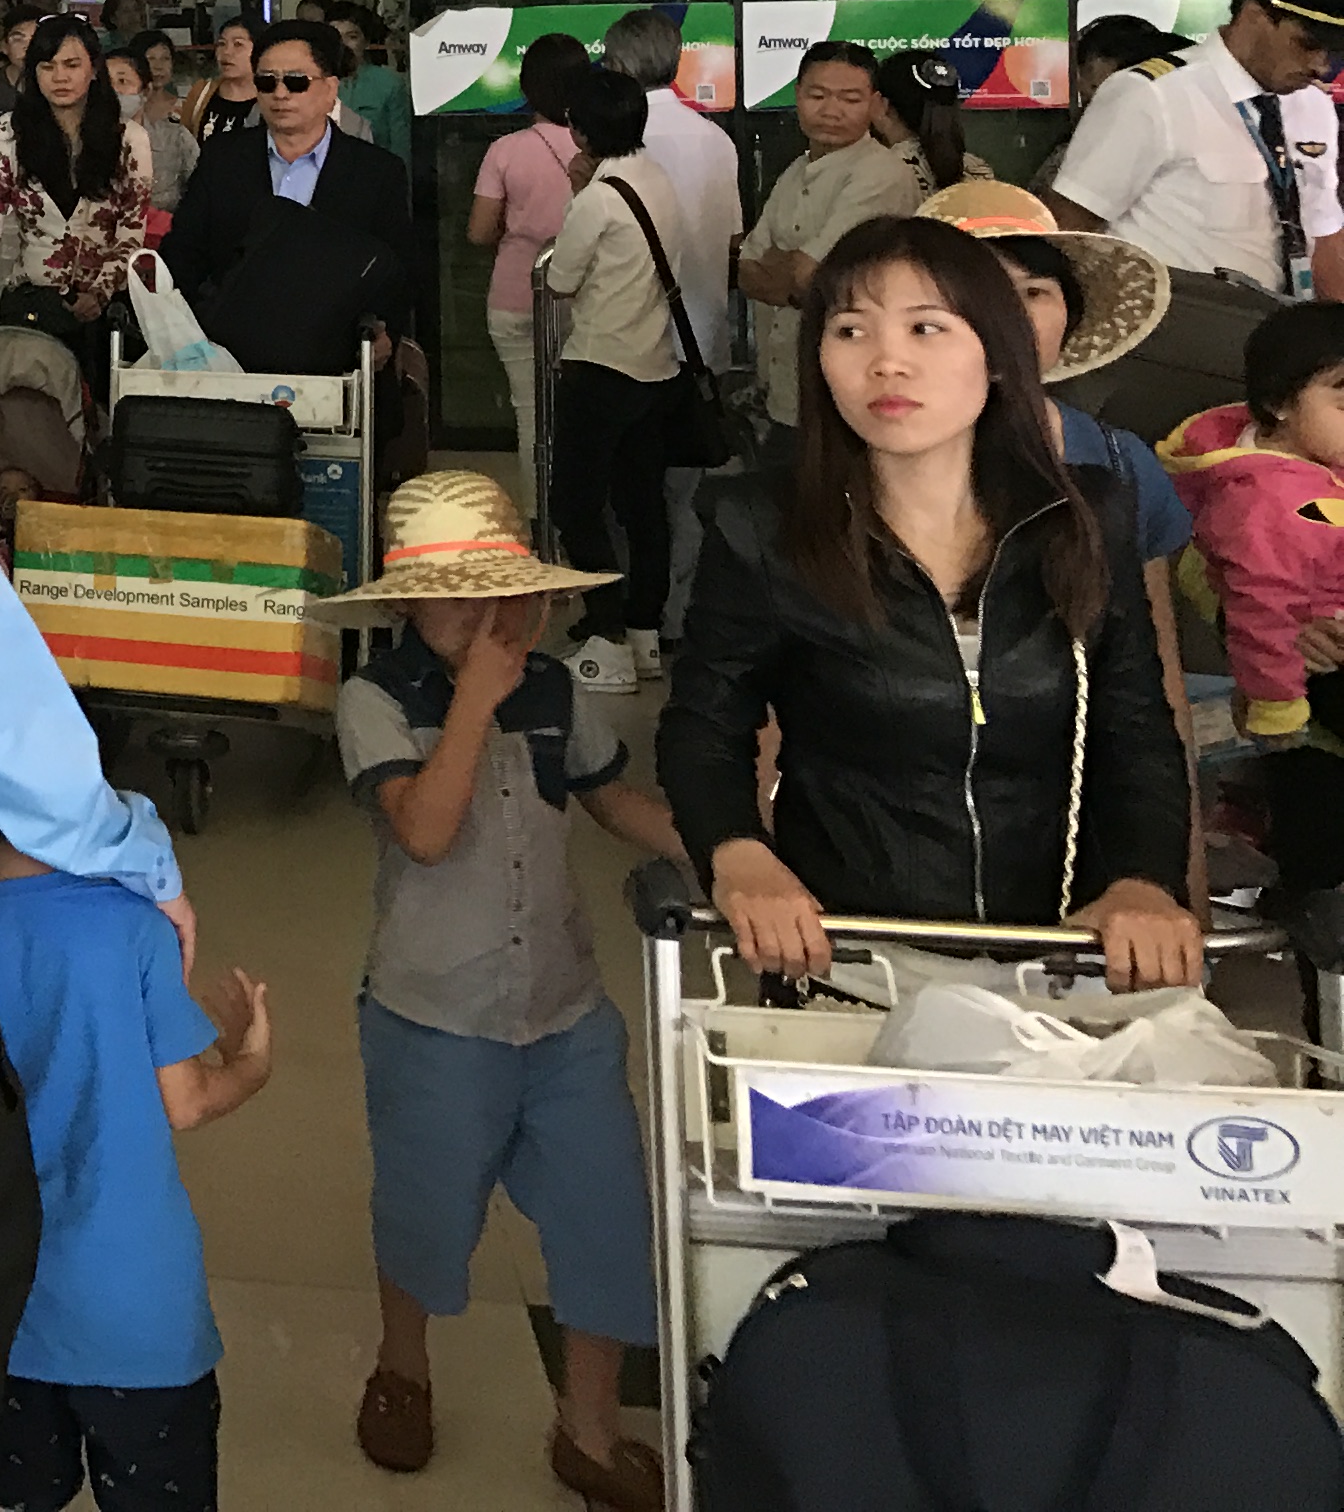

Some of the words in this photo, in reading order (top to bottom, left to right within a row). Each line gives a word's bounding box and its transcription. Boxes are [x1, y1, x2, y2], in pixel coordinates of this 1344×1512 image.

[438, 41, 488, 56] Amway
[758, 34, 809, 50] Amway
[867, 37, 908, 52] CUỘC
[952, 32, 982, 49] TỐT
[984, 35, 1010, 52] ĐẸP
[19, 579, 68, 599] Range
[74, 583, 175, 609] Development
[179, 592, 248, 613] Samples
[1031, 1123, 1072, 1144] MAY
[1129, 1130, 1175, 1149] NAM
[1199, 1184, 1292, 1204] VINATEX
